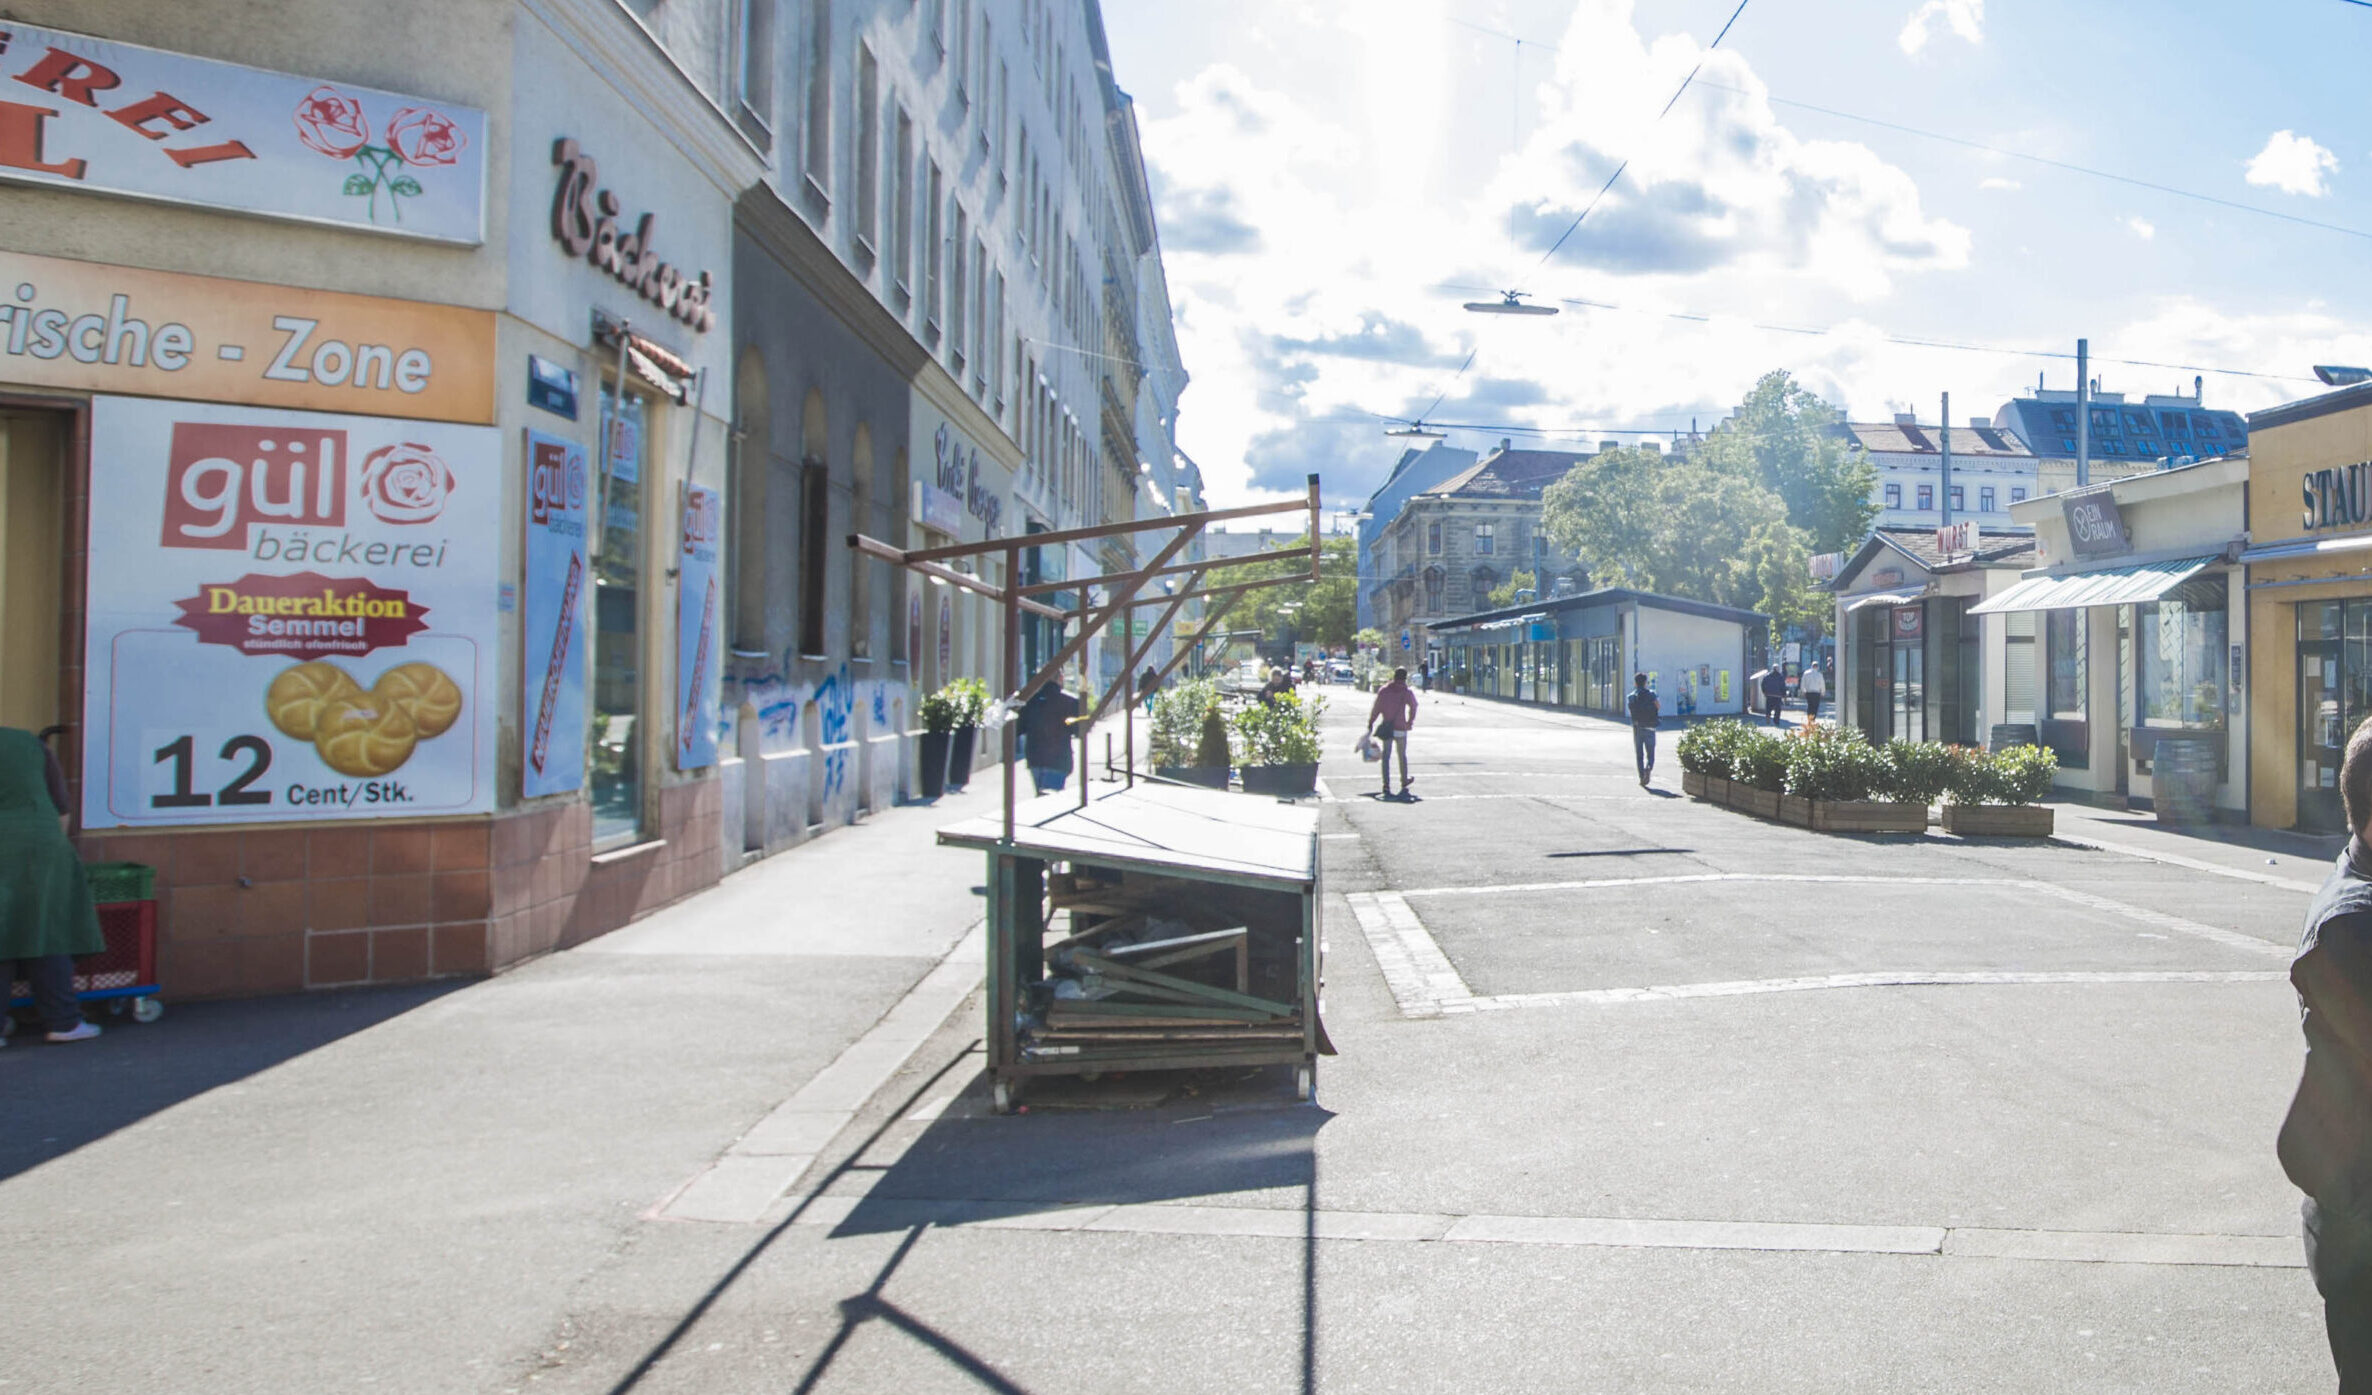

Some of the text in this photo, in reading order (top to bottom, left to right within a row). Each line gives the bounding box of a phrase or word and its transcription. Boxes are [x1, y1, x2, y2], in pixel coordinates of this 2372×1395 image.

[263, 315, 431, 394] Zone
[180, 437, 334, 538] gül
[2303, 461, 2372, 530] STAU
[253, 529, 447, 568] bäckerei
[1937, 520, 1969, 553] WURST
[208, 587, 406, 618] Daueraktion
[247, 614, 365, 637] Semmel
[151, 735, 414, 809] 12 Cent/Stk.
